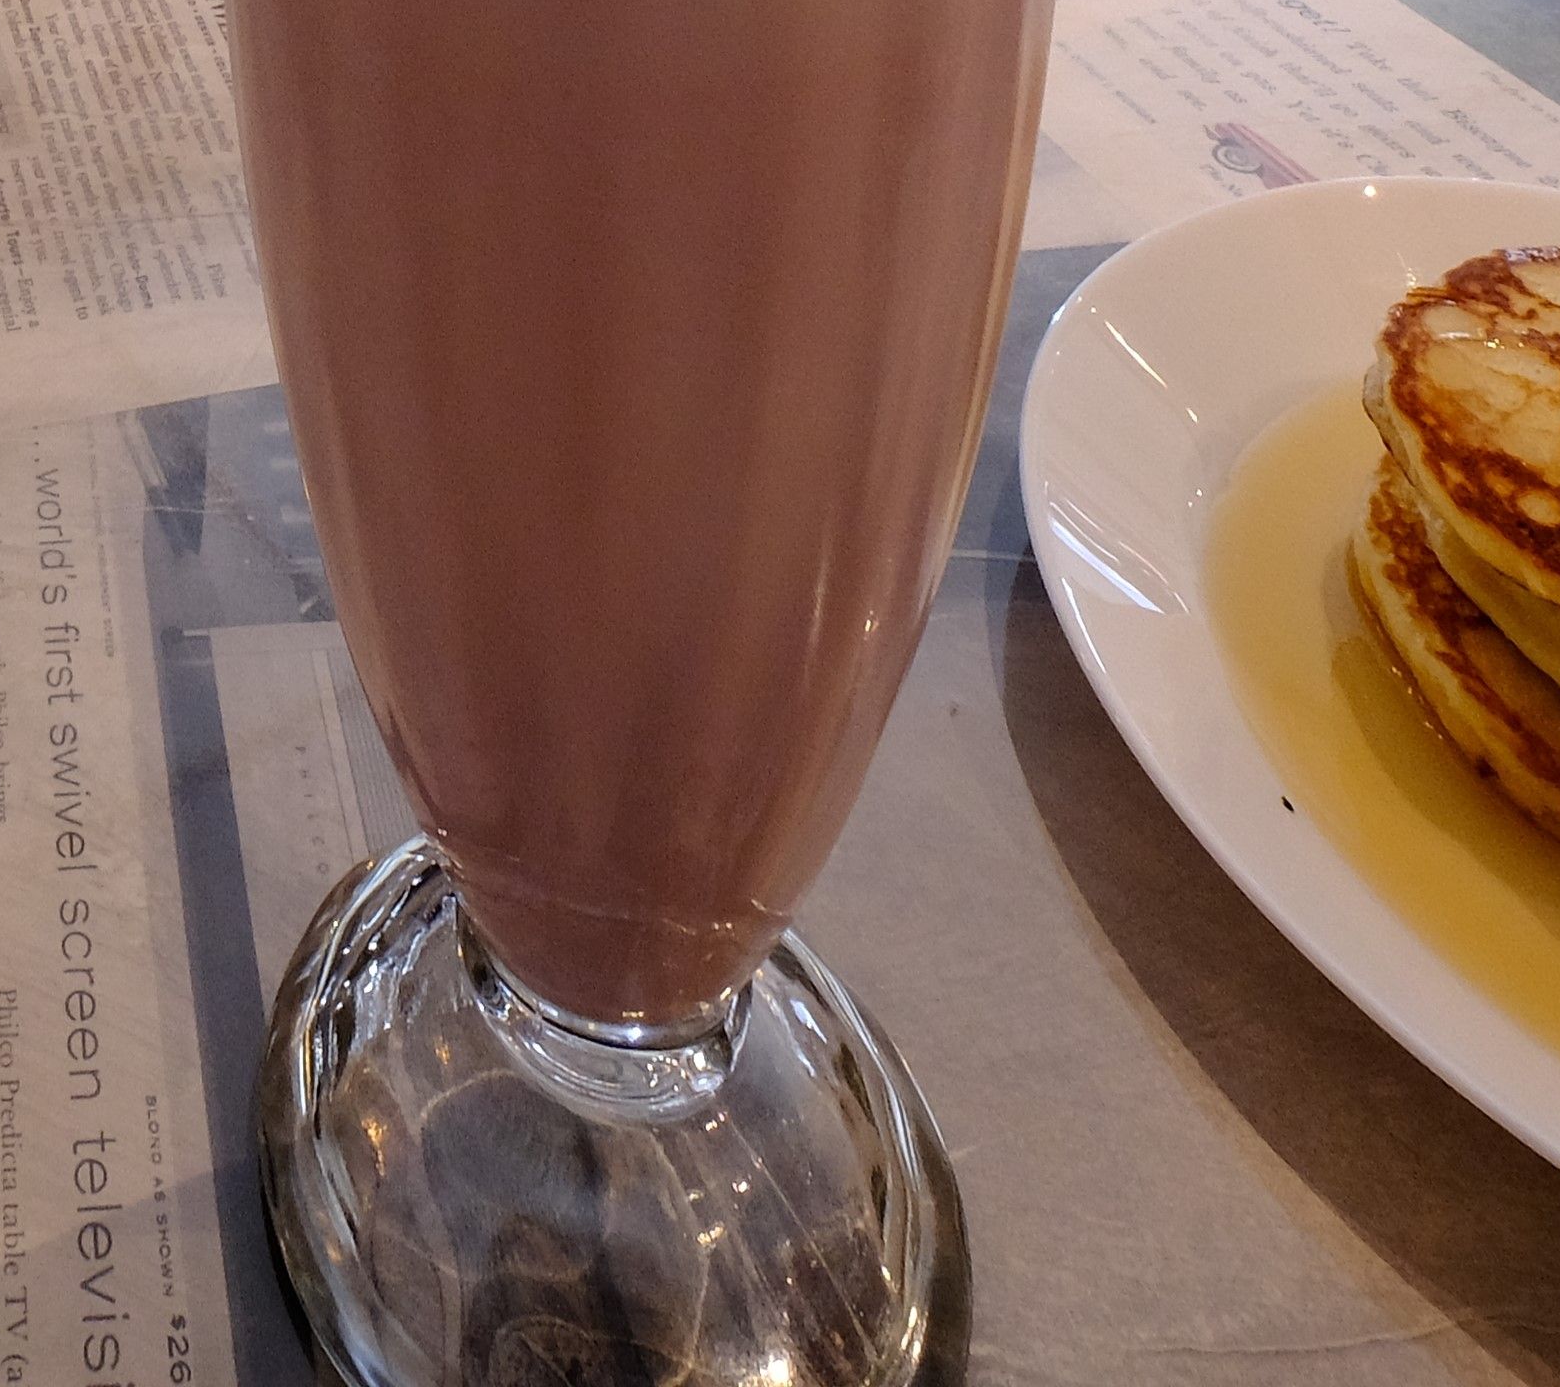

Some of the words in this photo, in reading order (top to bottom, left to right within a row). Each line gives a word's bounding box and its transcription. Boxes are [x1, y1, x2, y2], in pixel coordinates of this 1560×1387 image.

[43, 623, 84, 706] first
[49, 722, 98, 872] swivel
[59, 895, 106, 1100] screen
[0, 1074, 22, 1192] Predicta
[3, 1202, 25, 1277] table
